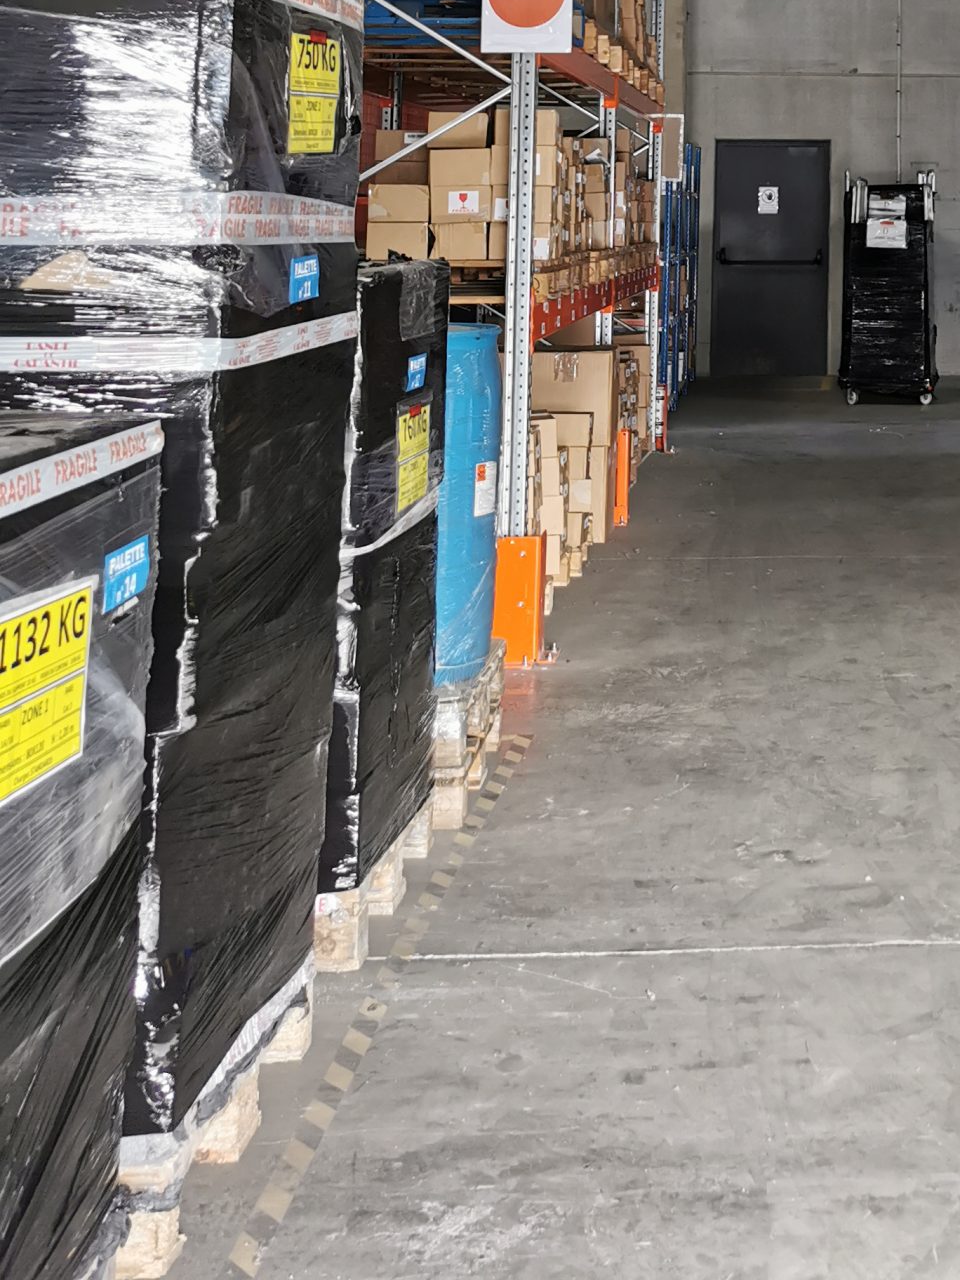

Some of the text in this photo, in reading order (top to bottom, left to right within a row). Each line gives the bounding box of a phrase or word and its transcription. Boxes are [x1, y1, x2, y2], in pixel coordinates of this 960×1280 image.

[297, 38, 337, 72] 750 KG
[227, 195, 264, 215] FRAGILE
[0, 431, 147, 508] RAGILE FRAGILE FRAGILE
[108, 541, 146, 577] PALETTE
[0, 595, 88, 675] 1132 KG
